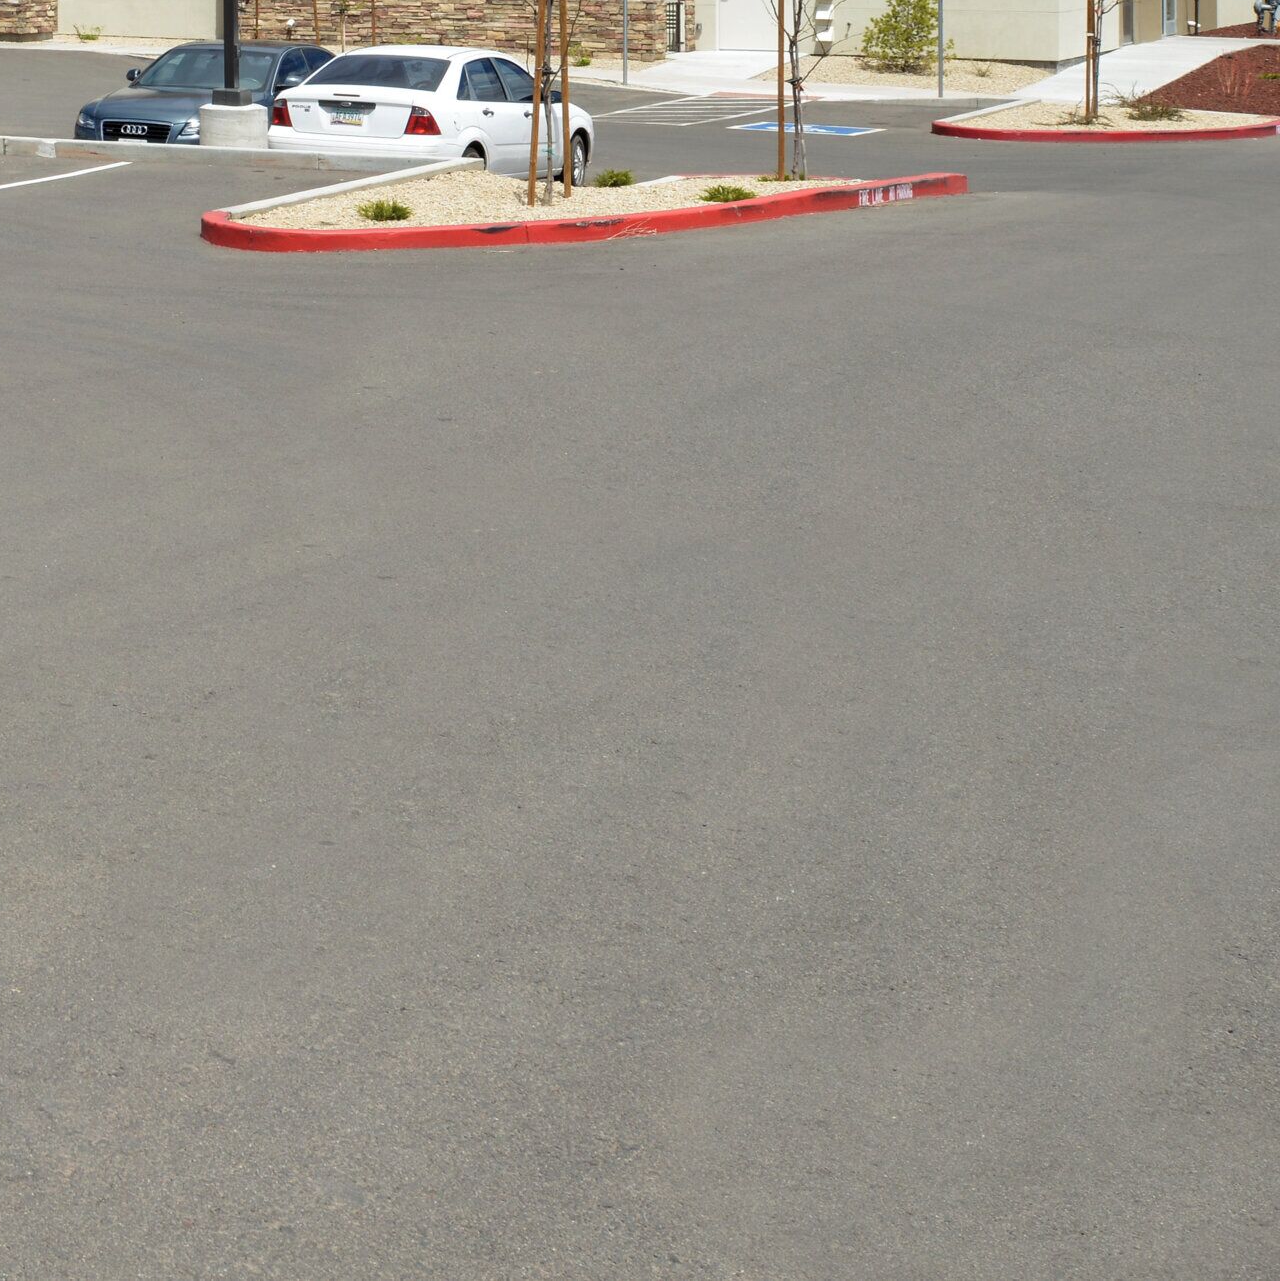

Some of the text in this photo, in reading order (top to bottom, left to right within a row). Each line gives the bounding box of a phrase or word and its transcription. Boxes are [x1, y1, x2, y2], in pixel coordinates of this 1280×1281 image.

[859, 190, 869, 206] FIRE
[872, 187, 884, 205] LANE
[897, 183, 912, 199] PARKING
